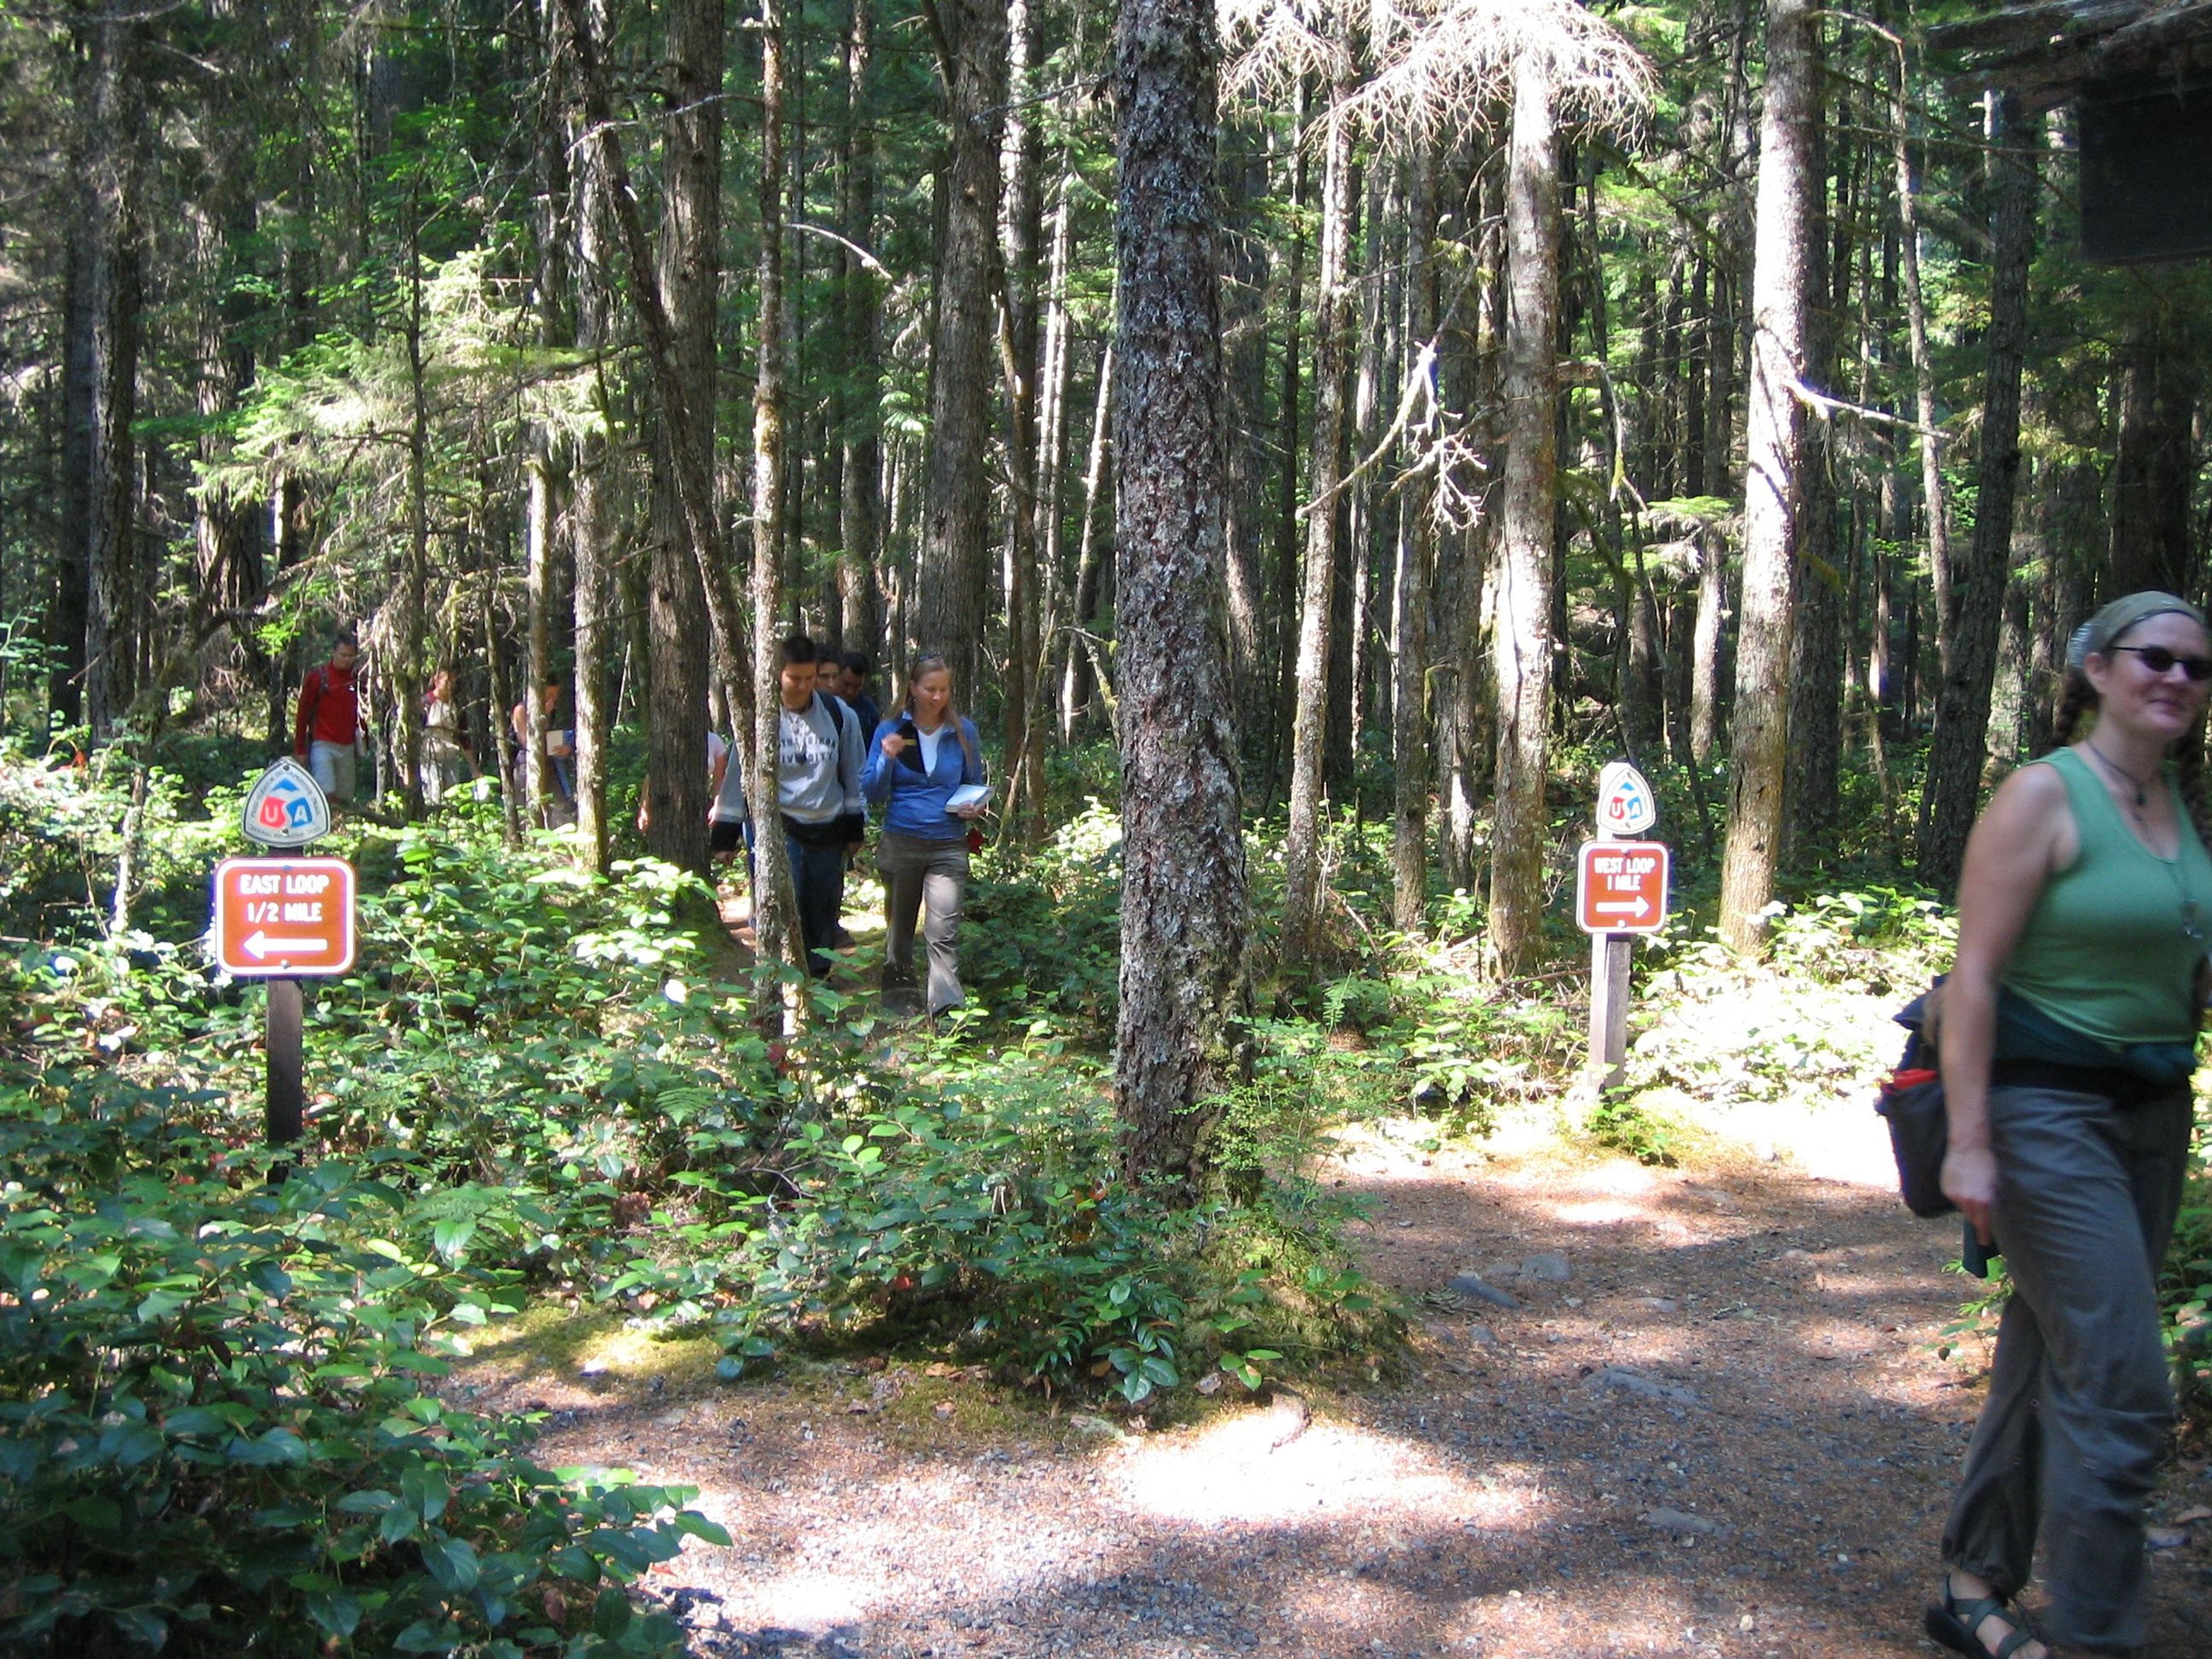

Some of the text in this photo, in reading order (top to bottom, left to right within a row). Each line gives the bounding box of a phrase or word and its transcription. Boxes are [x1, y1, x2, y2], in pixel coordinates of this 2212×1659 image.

[263, 802, 311, 826] USA
[1611, 799, 1642, 818] USA
[1594, 857, 1655, 874] WEST LOOP
[240, 874, 329, 894] EAST LOOP
[1607, 874, 1641, 891] 1 MILE
[247, 901, 323, 923] 1/2 MILE
